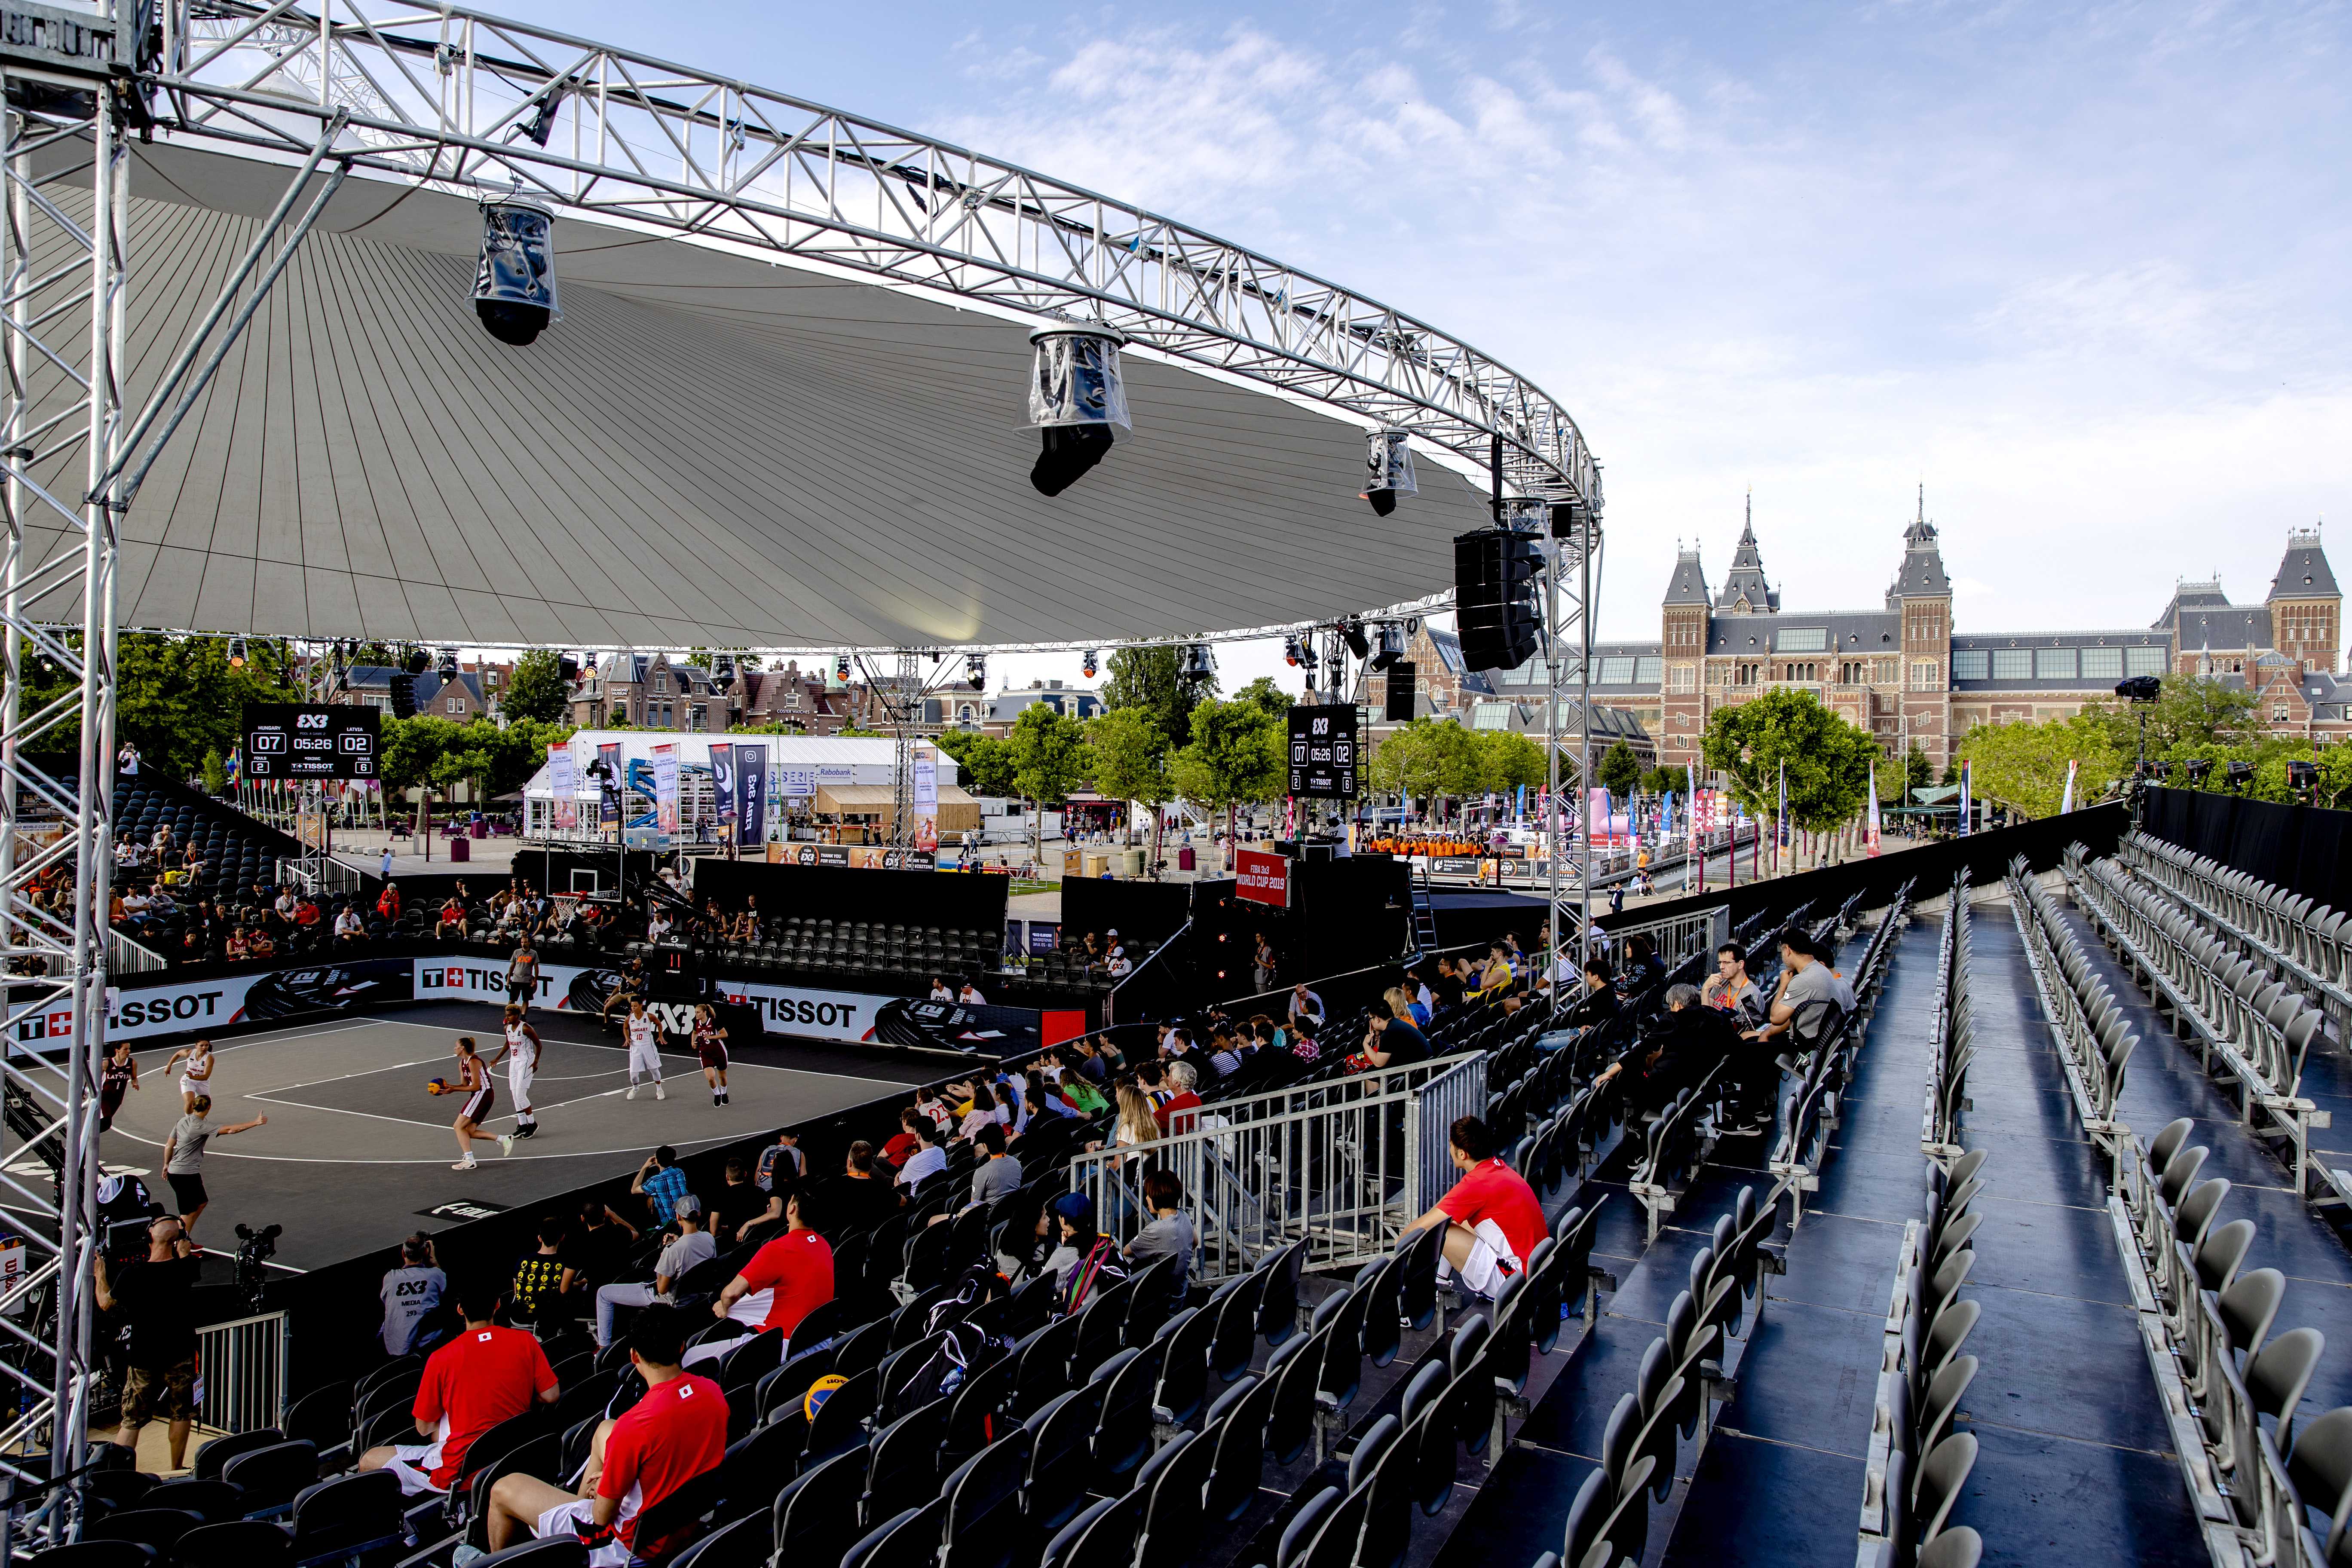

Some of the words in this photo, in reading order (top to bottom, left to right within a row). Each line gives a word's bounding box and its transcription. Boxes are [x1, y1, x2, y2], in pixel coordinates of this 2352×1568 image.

[297, 714, 328, 728] 3X3
[1313, 718, 1329, 735] 3X3
[258, 736, 280, 750] 07
[294, 738, 332, 750] 05:26
[345, 738, 366, 750] 02
[1295, 746, 1305, 762] 07
[1311, 748, 1330, 761] 05:26
[1337, 746, 1349, 763] 02
[1294, 778, 1298, 787] 2
[1345, 780, 1349, 789] 6
[1250, 865, 1260, 874] FIBA
[1261, 865, 1269, 874] 3x3
[1237, 874, 1256, 886] WORLD
[1257, 875, 1268, 888] CUP
[1269, 877, 1284, 890] 2019
[671, 954, 680, 968] 11
[289, 972, 320, 984] 12
[323, 969, 341, 986] TISSOT
[750, 996, 857, 1028] TISSOT
[915, 1004, 946, 1018] 12
[948, 1008, 967, 1025] TISSOT
[929, 1104, 949, 1124] 23
[396, 1280, 428, 1296] 3X3
